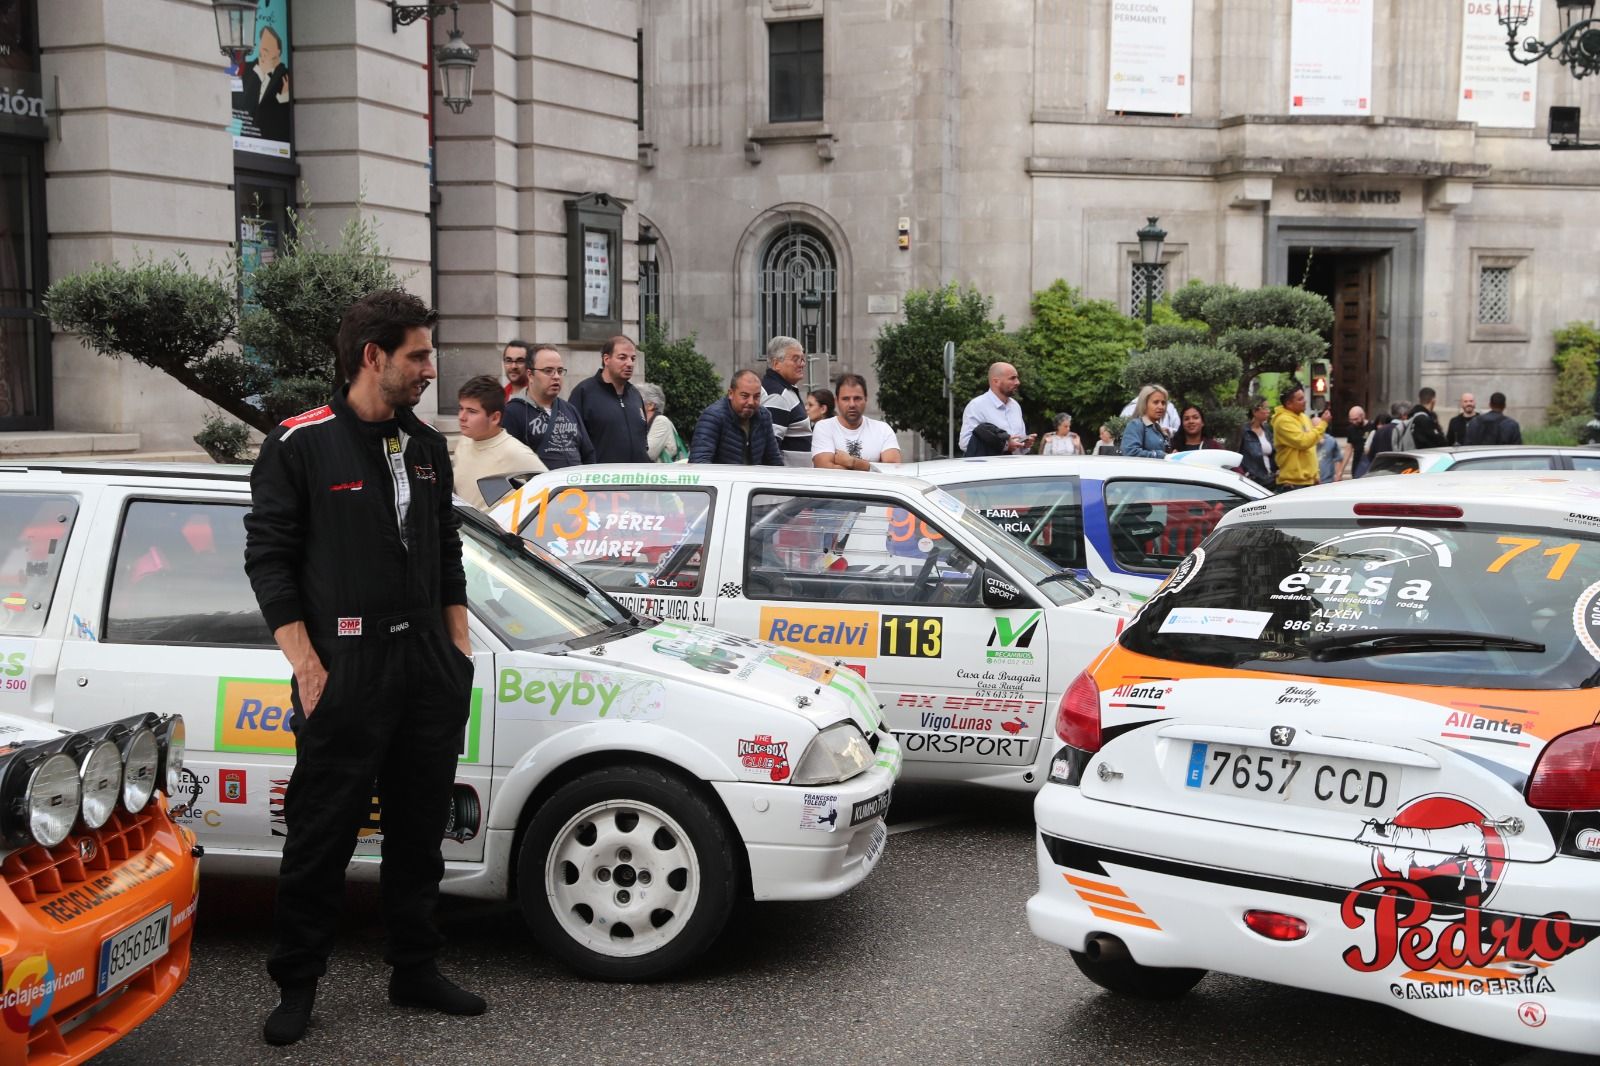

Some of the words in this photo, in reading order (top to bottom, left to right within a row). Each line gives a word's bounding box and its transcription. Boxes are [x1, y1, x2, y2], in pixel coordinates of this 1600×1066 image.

[1467, 3, 1492, 15] DAS
[1495, 4, 1535, 17] ARTES
[1114, 13, 1168, 25] PERMANENTE
[1295, 188, 1329, 203] CASA
[1330, 189, 1357, 204] DAS
[1359, 190, 1401, 205] ARTES
[585, 472, 700, 484] recambios_mv
[502, 487, 589, 541] 113
[604, 511, 665, 531] PÉREZ
[986, 509, 1019, 518] FARIA
[571, 536, 644, 558] SUÁREZ
[1485, 535, 1582, 581] 71
[1298, 564, 1350, 574] taller
[988, 586, 1015, 600] SPORT
[1278, 572, 1433, 602] ensa
[1323, 595, 1383, 606] electricidade
[1396, 601, 1424, 610] rodas
[652, 599, 665, 619] DE
[692, 601, 709, 622] S.L.
[1311, 607, 1363, 621] ALXÉN
[340, 620, 361, 629] OMP
[1282, 619, 1312, 631] 986
[1314, 621, 1334, 633] 65
[768, 617, 869, 646] Recalvi
[885, 617, 941, 657] 113
[994, 651, 1033, 659] RECAMBIOS
[956, 668, 979, 679] Casa
[982, 670, 995, 680] da
[997, 671, 1041, 684] Bragaña
[6, 679, 27, 690] 500
[977, 681, 997, 689] Casa
[998, 682, 1025, 691] Rural
[1113, 684, 1164, 699] Allanta
[498, 667, 622, 718] Beyby
[975, 690, 992, 698] 678
[992, 690, 1007, 699] 613
[1009, 691, 1024, 700] 776
[943, 696, 1043, 714] SPORT
[1275, 694, 1321, 707] Garage
[920, 712, 993, 732] VigoLunas
[1445, 711, 1523, 735] Allanta
[744, 756, 775, 769] CLUB
[1191, 769, 1199, 780] E
[1209, 751, 1302, 795] 7657
[1314, 764, 1388, 809] CCD
[803, 793, 838, 802] FRANCISCO
[804, 799, 827, 807] TOLEDO
[854, 799, 878, 821] KUMHO
[1340, 876, 1585, 973] Pedro
[110, 929, 144, 976] 8356
[143, 914, 169, 956] BZW
[1389, 972, 1556, 999] CARNICERÍA
